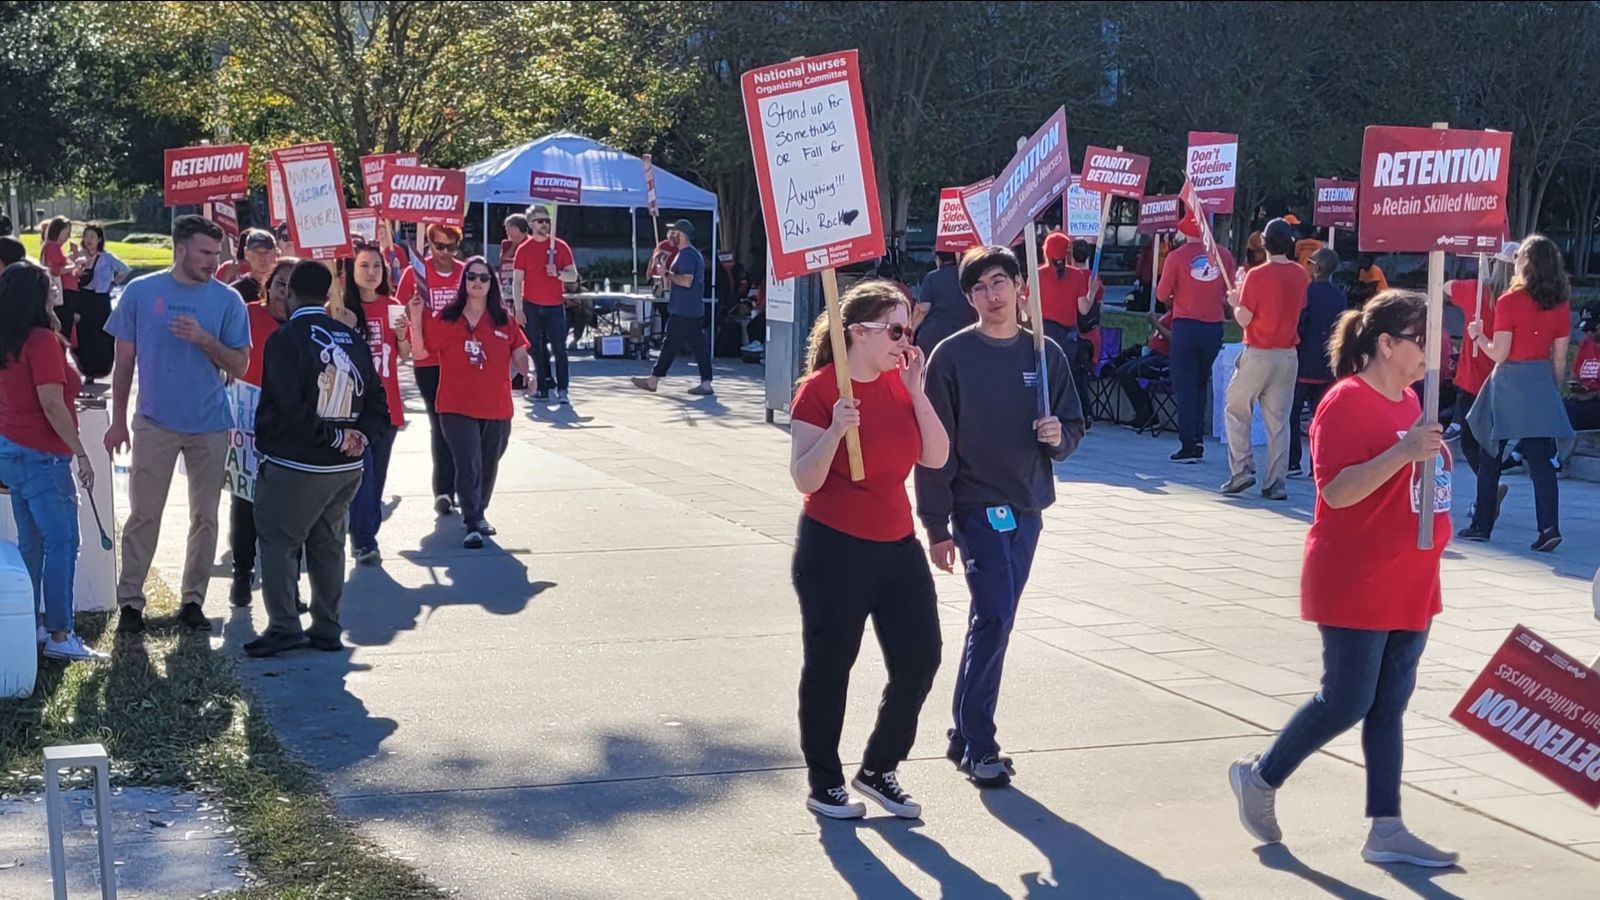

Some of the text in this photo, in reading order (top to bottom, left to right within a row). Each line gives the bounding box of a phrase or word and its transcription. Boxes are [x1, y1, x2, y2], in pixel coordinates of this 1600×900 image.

[754, 58, 847, 84] National Nurses
[755, 70, 848, 95] Organizing Committee
[765, 100, 807, 128] Stand
[811, 102, 824, 116] up
[802, 145, 823, 161] Fall
[831, 140, 845, 153] for
[1191, 147, 1220, 163] Don't
[171, 152, 244, 178] RETENTION
[995, 121, 1060, 219] RETENTION
[1039, 151, 1063, 183] Nurses
[1090, 154, 1134, 171] CHARITY
[1190, 161, 1232, 176] Sideline
[1373, 147, 1502, 188] RETENTION
[199, 175, 222, 188] Skilled
[222, 174, 244, 184] Nurses
[390, 173, 446, 192] CHARITY
[533, 176, 579, 189] RETENTION
[1086, 168, 1142, 187] BETRAYED!
[1191, 174, 1225, 188] Nurses
[388, 192, 459, 211] BETRAYED!
[1069, 198, 1100, 211] STRIKE
[1317, 187, 1356, 202] RETENTION
[1423, 192, 1462, 214] Skilled
[1463, 193, 1499, 211] Nurses
[1141, 199, 1177, 215] RETENTION
[1494, 663, 1537, 698] Nurses
[1539, 687, 1585, 721] Skilled
[1467, 687, 1600, 782] RETENTION
